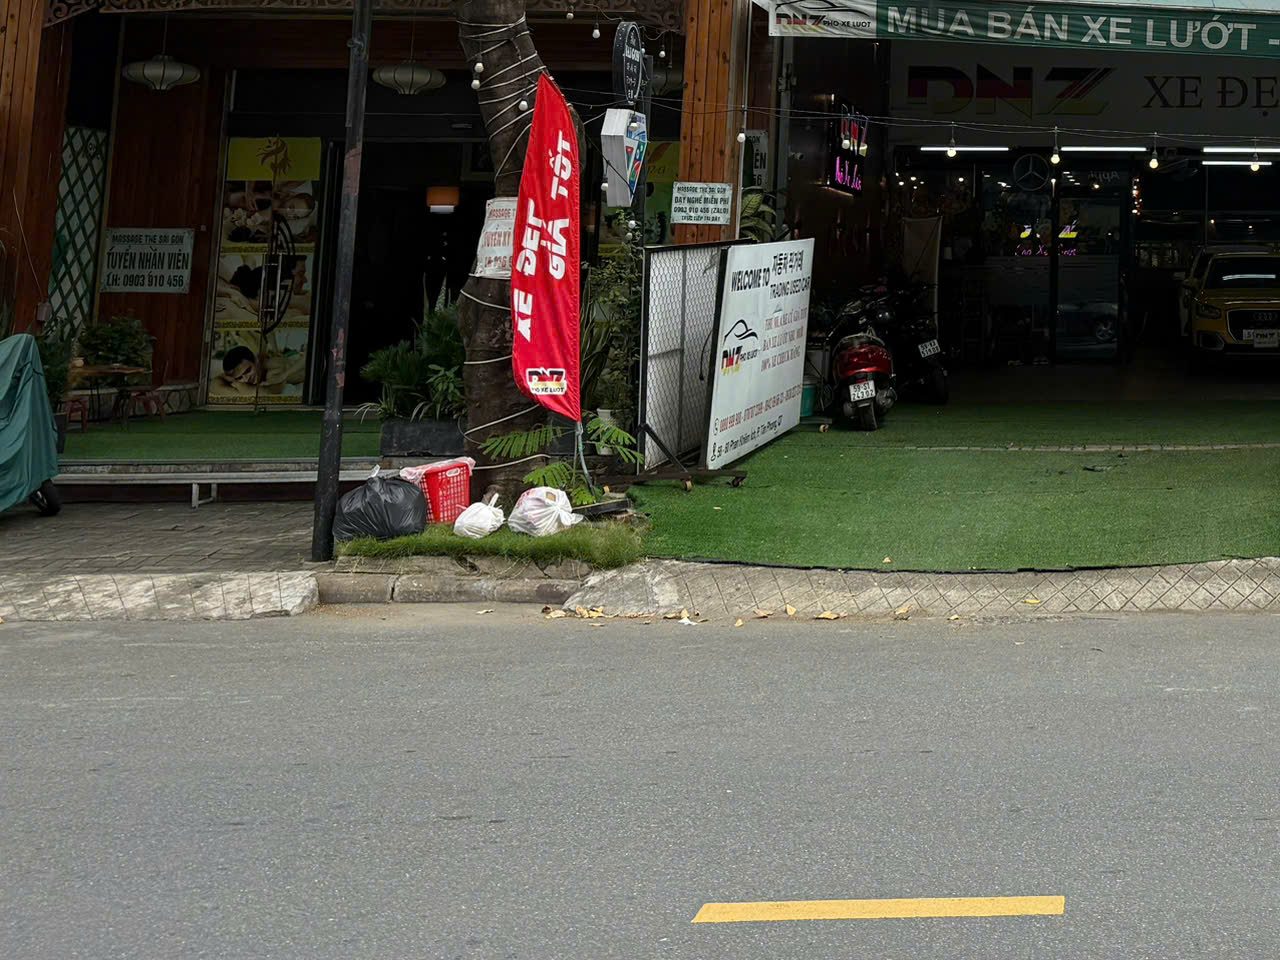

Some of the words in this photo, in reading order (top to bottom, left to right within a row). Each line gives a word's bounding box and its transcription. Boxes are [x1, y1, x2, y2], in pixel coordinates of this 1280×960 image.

[886, 5, 976, 37] MUA
[986, 6, 1069, 41] BÁN
[1081, 15, 1133, 45] XE
[1146, 14, 1257, 51] LƯỚT
[908, 64, 1116, 120] DNZ
[1142, 75, 1203, 109] XE
[549, 130, 572, 200] TỐT
[168, 248, 190, 270] VIÊN
[541, 217, 570, 280] GIÁ
[123, 274, 145, 287] 0903
[148, 274, 165, 287] 910
[167, 275, 184, 287] 456
[731, 268, 762, 292] WELCOME
[762, 267, 770, 287] TO
[513, 288, 533, 343] XE
